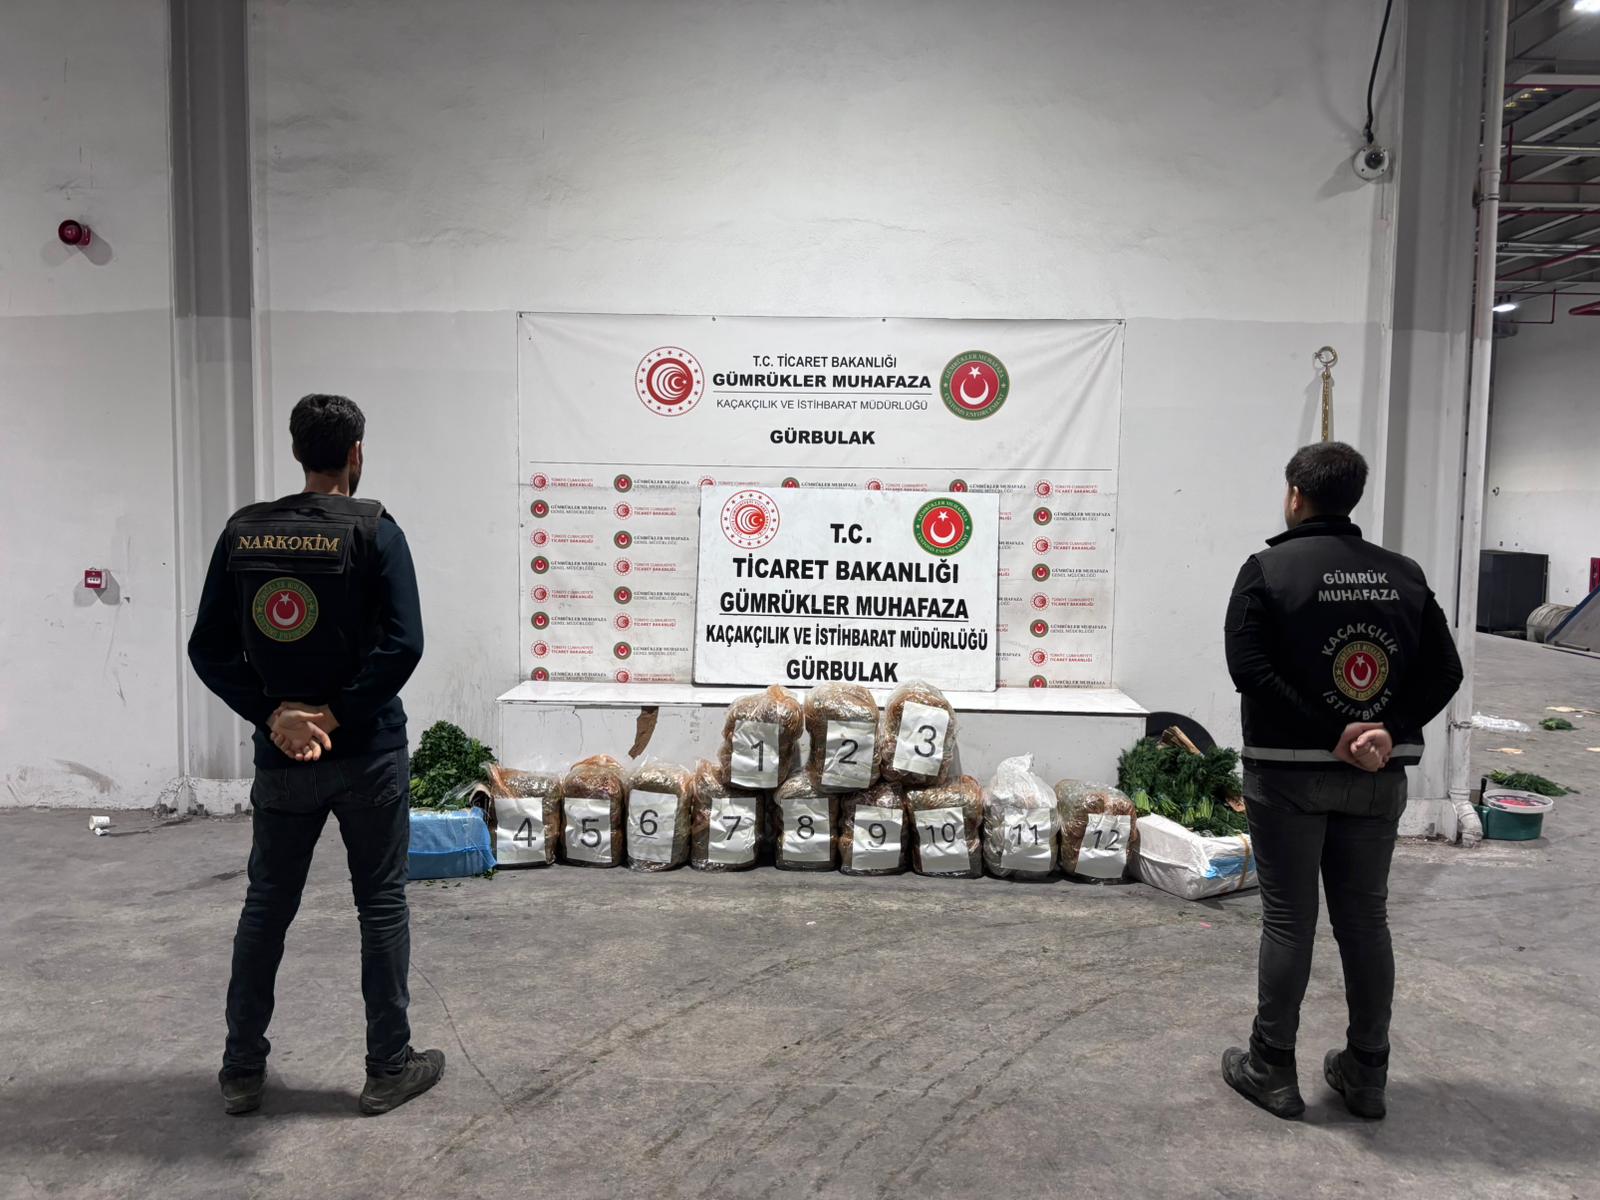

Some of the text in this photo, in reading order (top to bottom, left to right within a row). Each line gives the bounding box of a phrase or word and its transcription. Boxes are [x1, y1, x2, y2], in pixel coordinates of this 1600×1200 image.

[753, 353, 896, 368] T.C. TİCARET BAKANLIĞI
[712, 372, 931, 388] GÜMRÜKLER MUHAFAZA
[717, 399, 777, 410] KAÇAKÇILIK
[798, 398, 857, 410] İSTİHBARAT
[860, 400, 928, 410] MÜDÜRLÜĞÜ
[770, 428, 875, 445] GÜRBULAK
[238, 534, 340, 551] NARKOKİM
[830, 524, 872, 543] T.C.
[733, 554, 958, 583] TİCARET BAKANLIĞI
[1323, 570, 1389, 585] GÜMRÜK
[720, 589, 968, 618] GÜMRÜKLER MUHAFAZA
[1318, 588, 1400, 602] MUHAFAZA
[706, 624, 988, 650] KAÇAKÇILIK VE İSTİHBARAT MÜDÜRLÜĞÜ
[1322, 622, 1398, 656] KAÇAKÇILIK
[786, 656, 898, 682] GÜRBULAK
[838, 739, 859, 764] 2
[914, 724, 937, 758] 3
[751, 741, 764, 772] 1
[513, 818, 536, 847] 4
[581, 818, 601, 848] 5
[640, 810, 657, 835] 6
[722, 816, 742, 841] 7
[796, 815, 815, 839] 8
[868, 823, 886, 846] 9
[927, 823, 956, 844] 10
[1012, 823, 1038, 845] 11
[1094, 829, 1120, 850] 12
